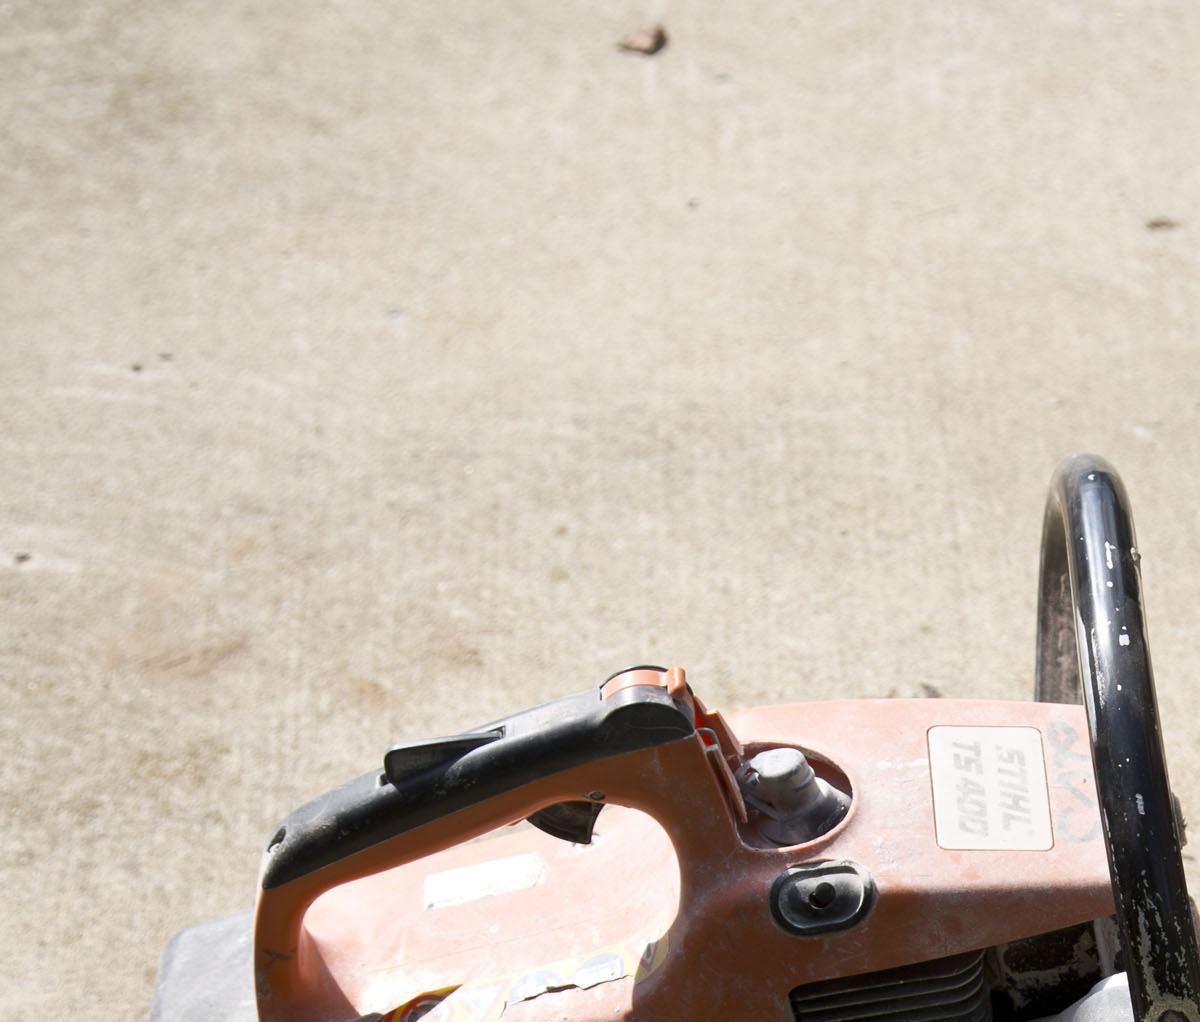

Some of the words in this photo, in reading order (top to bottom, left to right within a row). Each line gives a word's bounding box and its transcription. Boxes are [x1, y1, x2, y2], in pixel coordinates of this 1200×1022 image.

[951, 741, 984, 775] TS
[996, 744, 1032, 832] STIHL
[956, 777, 989, 838] 400
